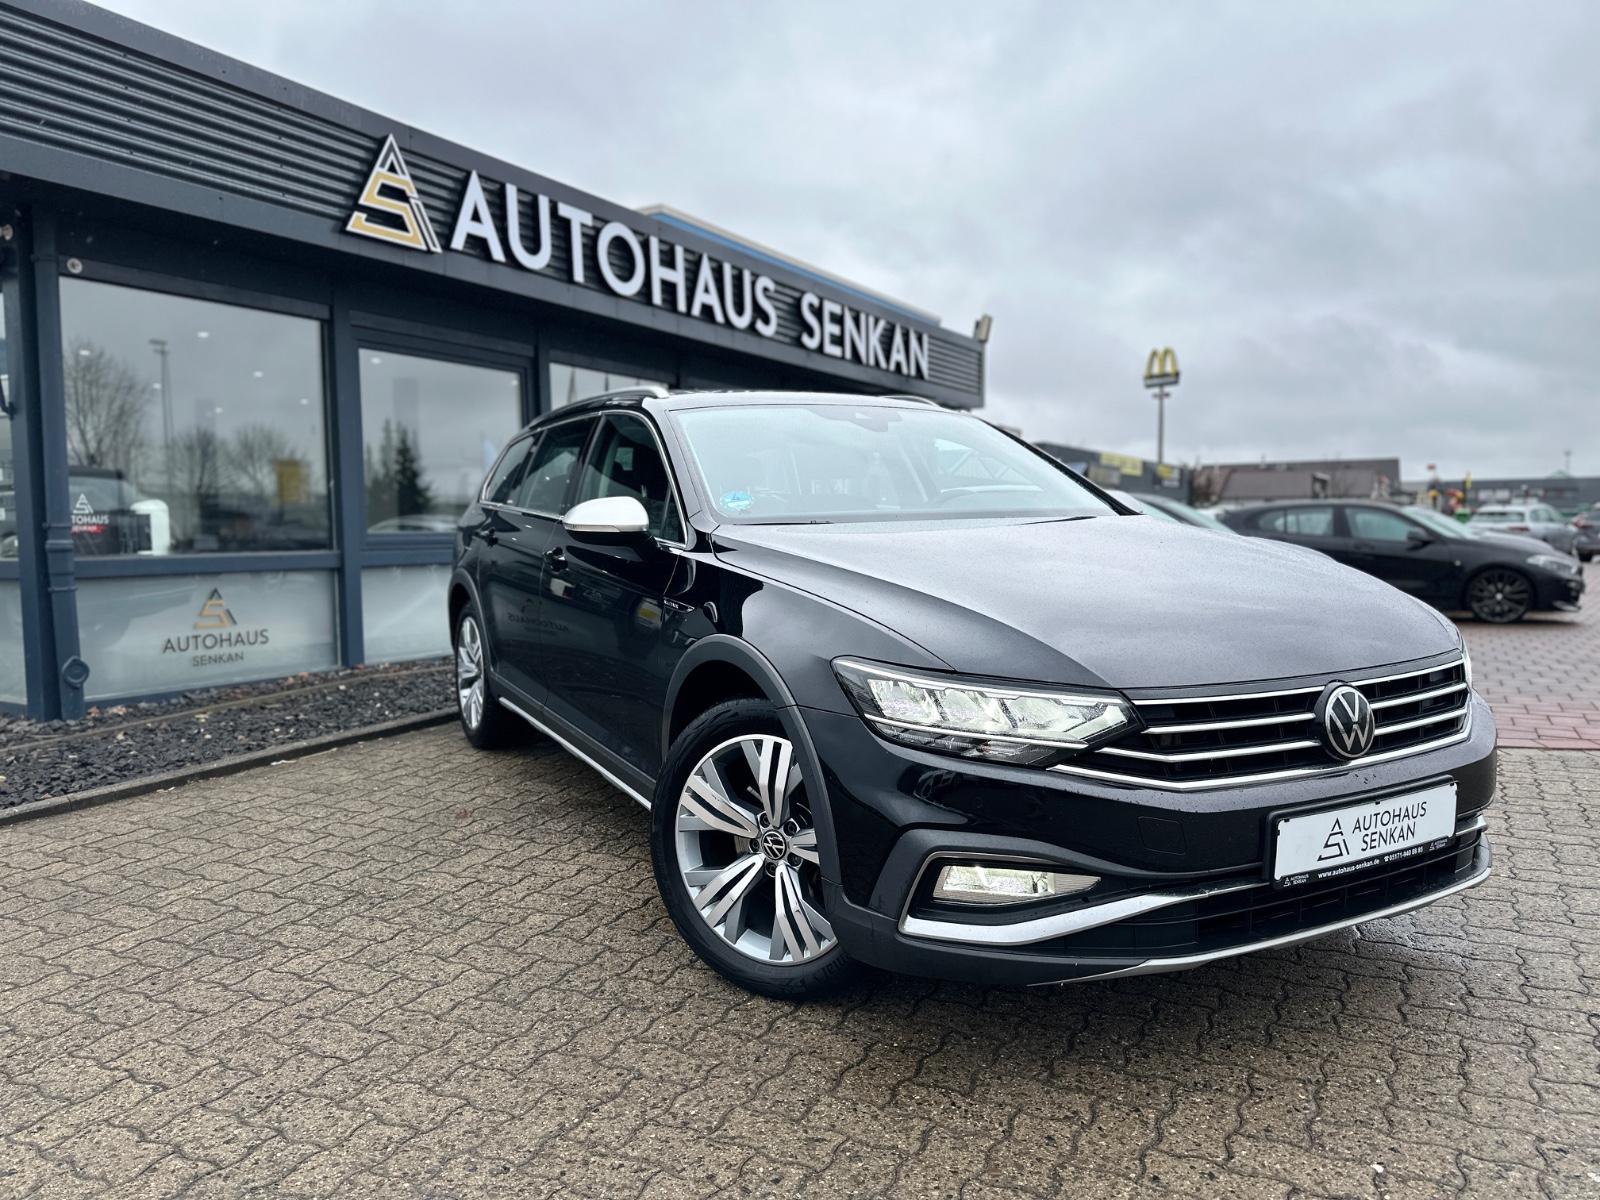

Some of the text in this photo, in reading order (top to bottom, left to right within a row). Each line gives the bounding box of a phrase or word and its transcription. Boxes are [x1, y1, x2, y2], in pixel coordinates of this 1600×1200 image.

[450, 169, 929, 380] AUTOHAUS SENKAN
[71, 515, 109, 525] TOHAUS
[163, 628, 270, 654] AUTOHAUS
[192, 651, 245, 667] SENKAN
[1352, 801, 1427, 834] AUTOHAUS
[1361, 821, 1416, 852] SENKAN
[1317, 859, 1380, 879] www.autohaus-senkan.de
